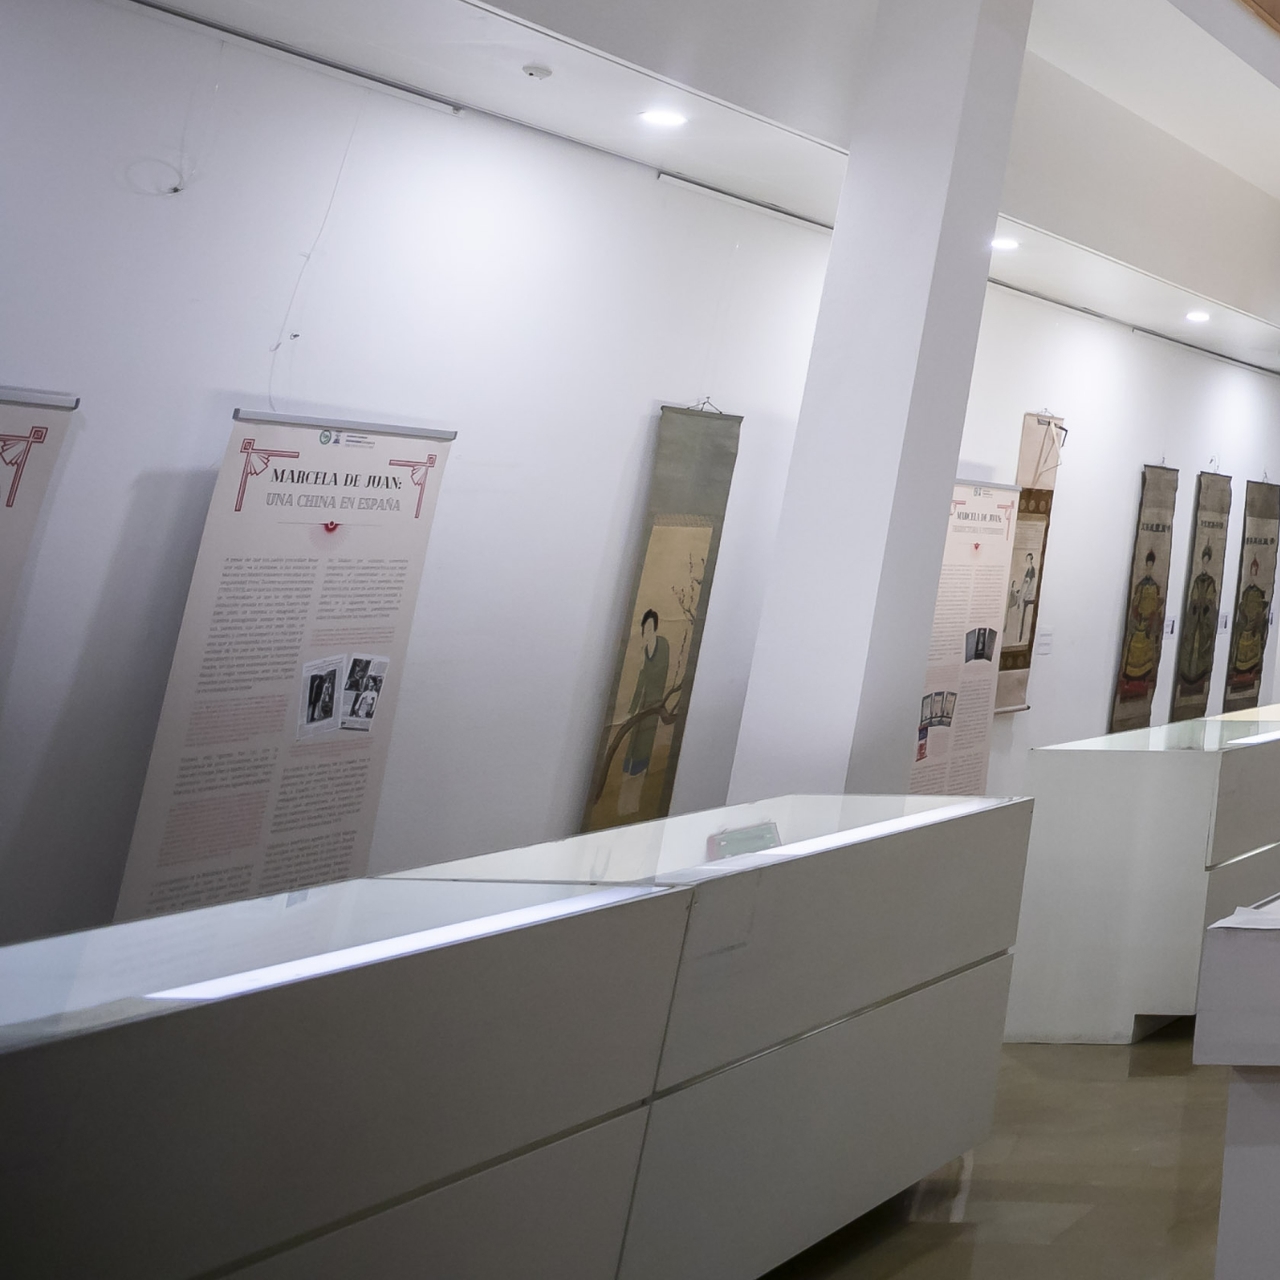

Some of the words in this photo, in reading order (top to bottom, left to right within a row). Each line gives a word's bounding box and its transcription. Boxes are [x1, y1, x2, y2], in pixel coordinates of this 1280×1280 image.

[271, 469, 338, 486] MARCELA
[344, 473, 361, 488] DE
[364, 475, 402, 490] JUAN:
[266, 493, 293, 507] UNA
[297, 494, 336, 509] CHINA
[340, 497, 355, 510] EN
[358, 496, 401, 512] ESPAÑA
